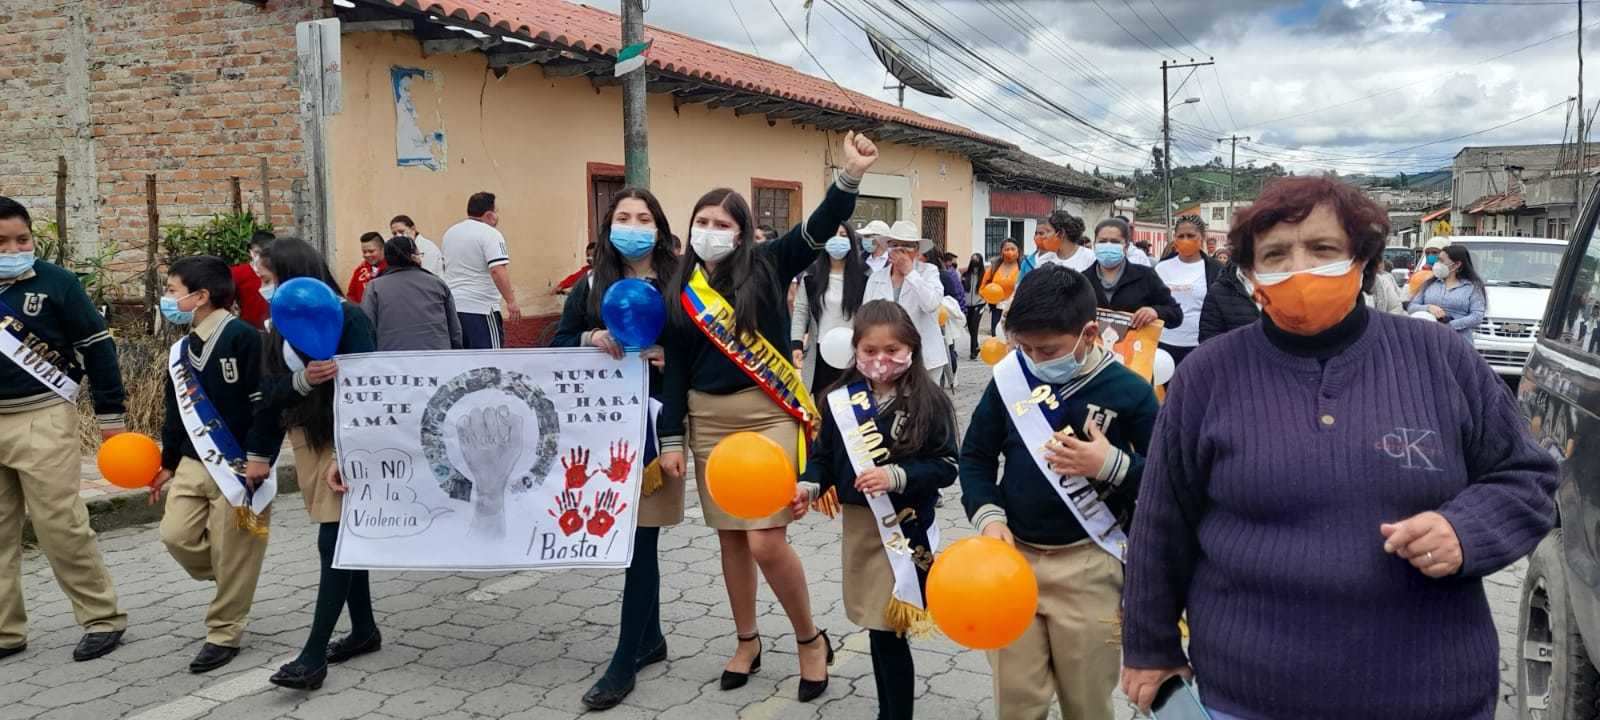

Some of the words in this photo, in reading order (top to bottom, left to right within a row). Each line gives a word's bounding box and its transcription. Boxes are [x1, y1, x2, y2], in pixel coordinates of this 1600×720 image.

[341, 375, 439, 387] ALGUIEN
[553, 368, 624, 381] NUNCA
[556, 383, 585, 394] TE
[344, 391, 383, 404] QUE
[383, 403, 411, 414] TE
[351, 415, 398, 427] AMA
[567, 410, 622, 423] DAÑO
[1383, 427, 1445, 472] CK
[351, 460, 368, 479] Di
[381, 459, 405, 479] NO
[361, 483, 372, 501] A
[386, 482, 400, 501] la
[354, 507, 418, 527] Violencia
